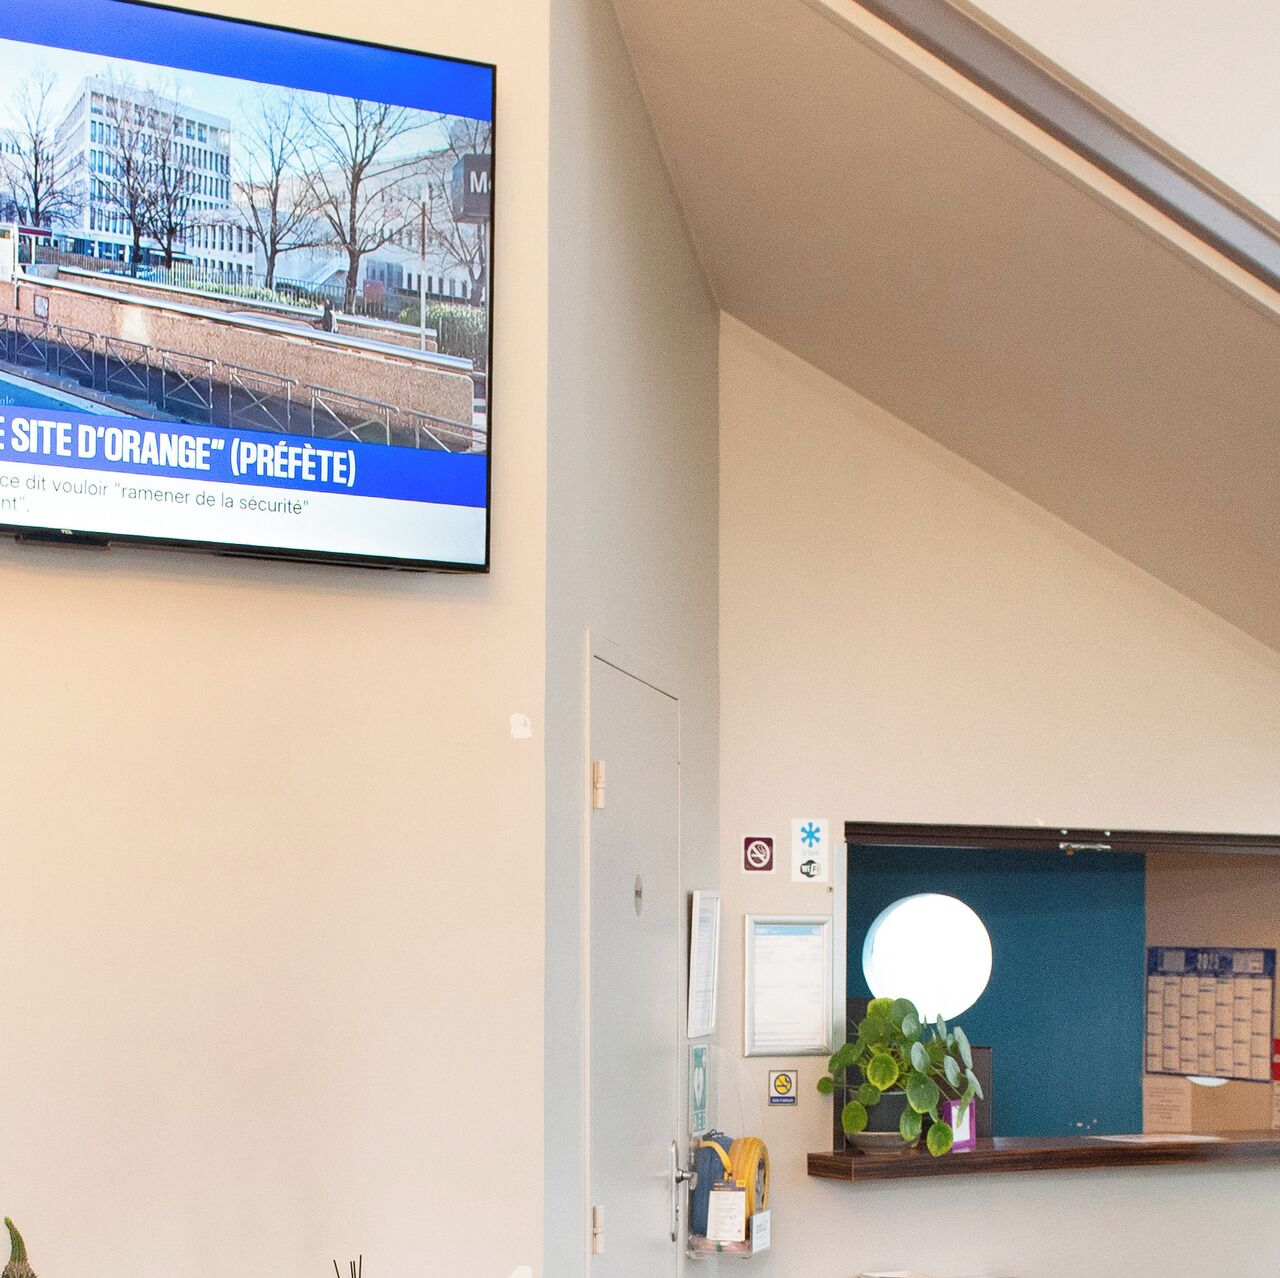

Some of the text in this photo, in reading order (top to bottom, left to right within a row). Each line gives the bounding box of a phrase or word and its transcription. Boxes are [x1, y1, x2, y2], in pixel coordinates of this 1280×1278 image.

[470, 171, 491, 193] M
[12, 416, 75, 457] SITE
[231, 438, 357, 488] (PRÉFÈTE)
[25, 474, 47, 492] dit
[52, 477, 108, 496] vouloir
[115, 482, 190, 505] "ramener
[195, 488, 216, 507] de
[220, 491, 234, 509] la
[239, 494, 309, 516] sécurité"
